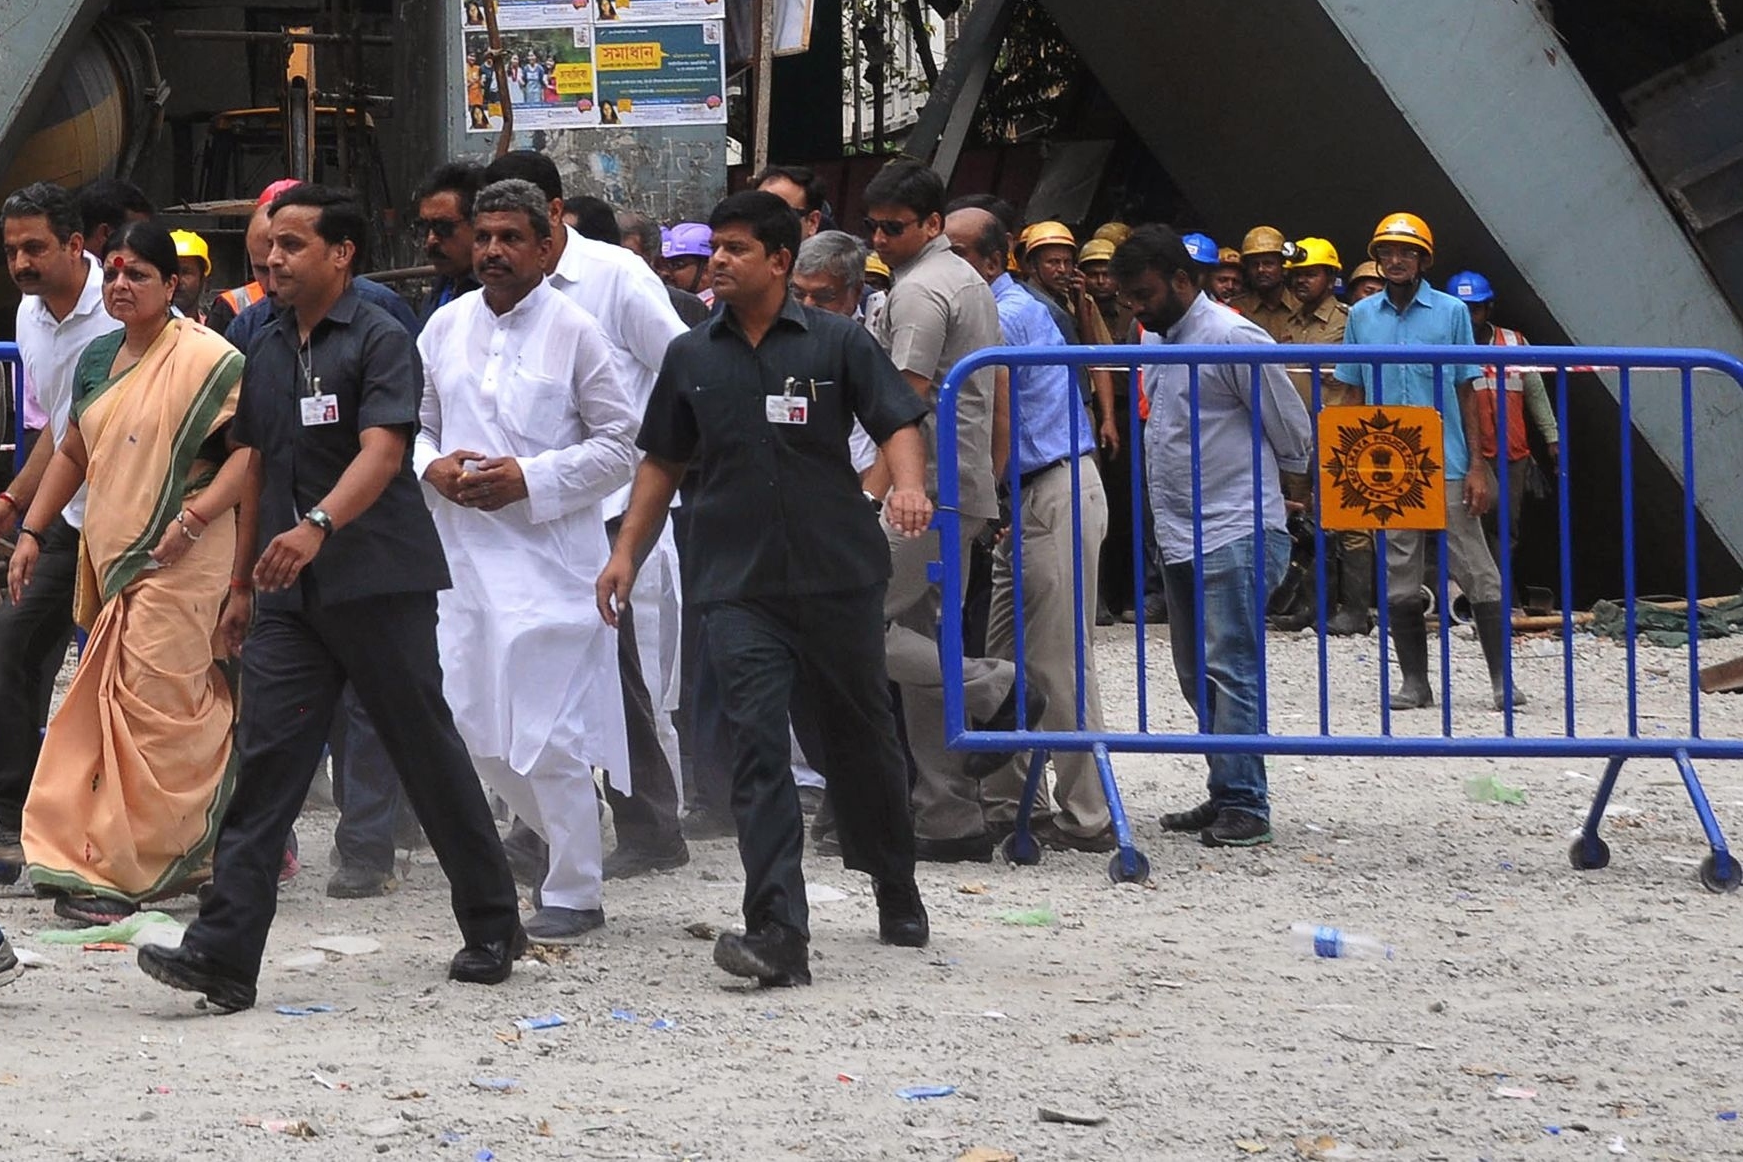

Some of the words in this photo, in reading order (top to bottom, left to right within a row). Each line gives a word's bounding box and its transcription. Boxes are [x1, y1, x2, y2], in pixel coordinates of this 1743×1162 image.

[602, 45, 654, 61] সমাধান
[1347, 438, 1371, 485] KOLKATA
[1373, 434, 1409, 453] POLICE
